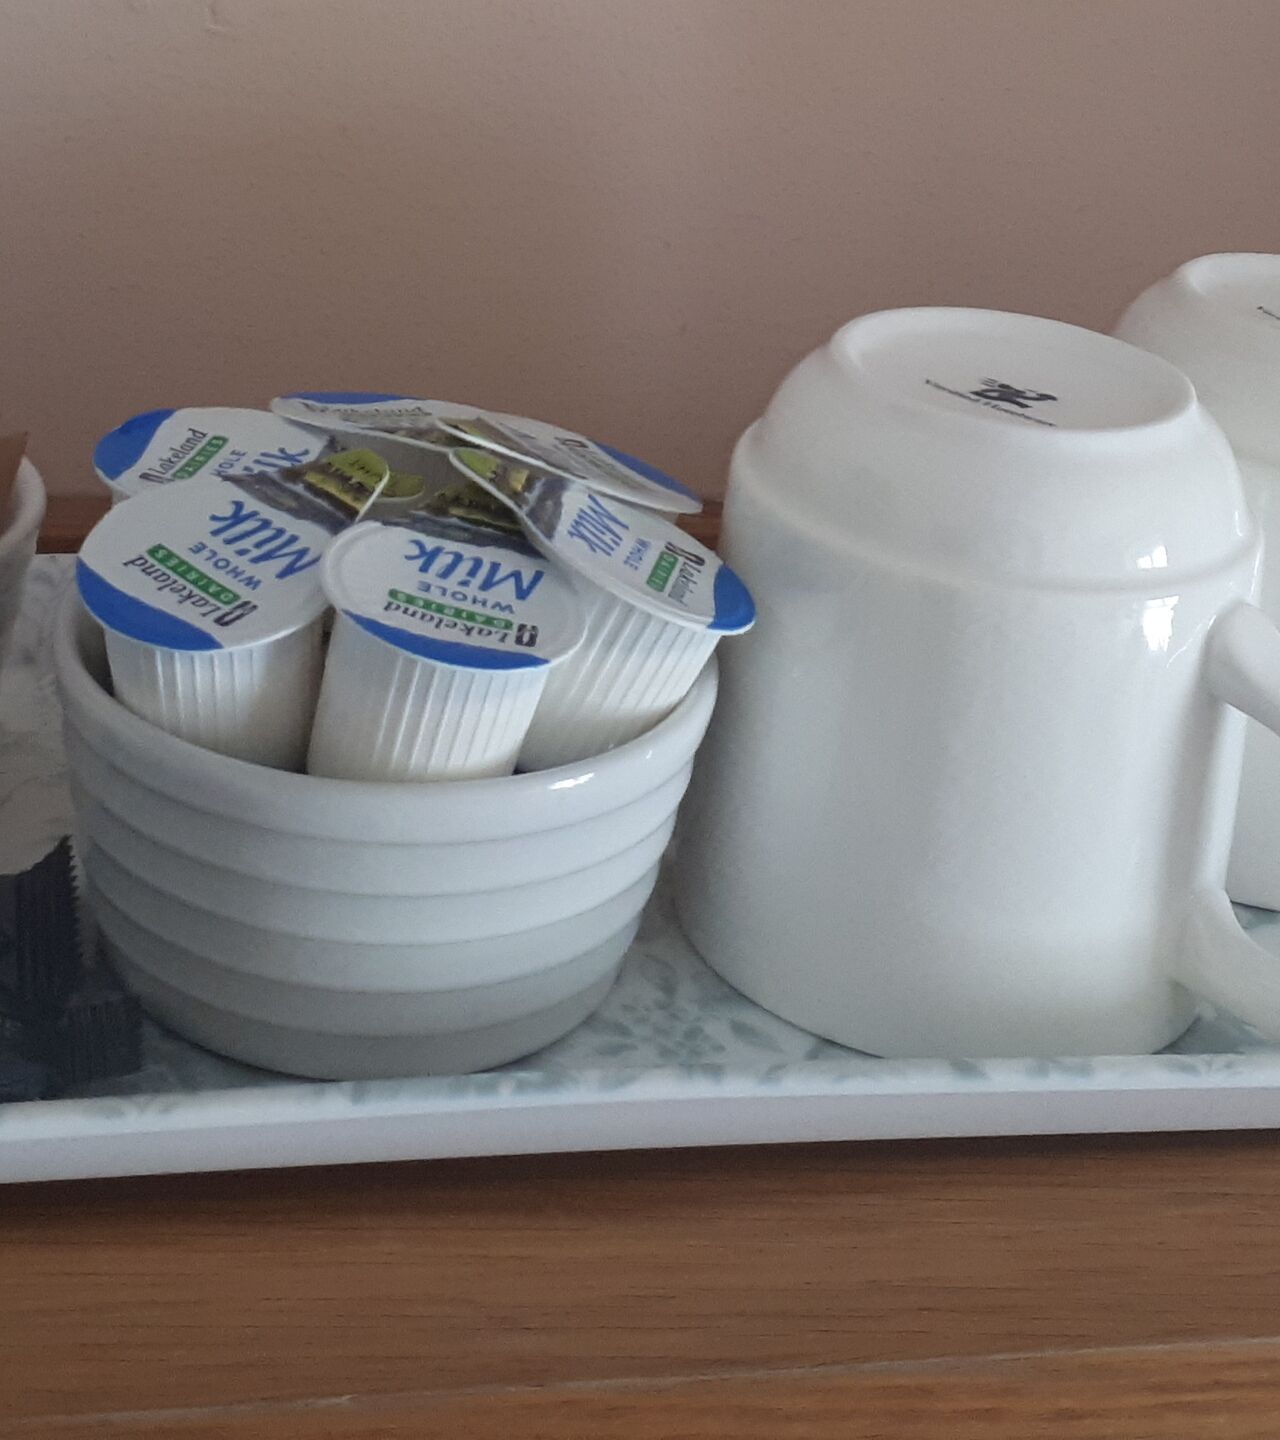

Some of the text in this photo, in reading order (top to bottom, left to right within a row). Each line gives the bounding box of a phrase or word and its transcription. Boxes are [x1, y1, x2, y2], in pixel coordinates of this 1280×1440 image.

[208, 500, 323, 581] Milk
[566, 494, 630, 556] Milk
[121, 555, 222, 619] Lakeland
[150, 547, 237, 603] DAIRIES
[188, 541, 263, 591] WHOLE
[402, 538, 546, 602] Milk
[381, 600, 511, 644] Lakeland
[391, 591, 508, 628] DAIRIES
[415, 579, 517, 615] WHOLE
